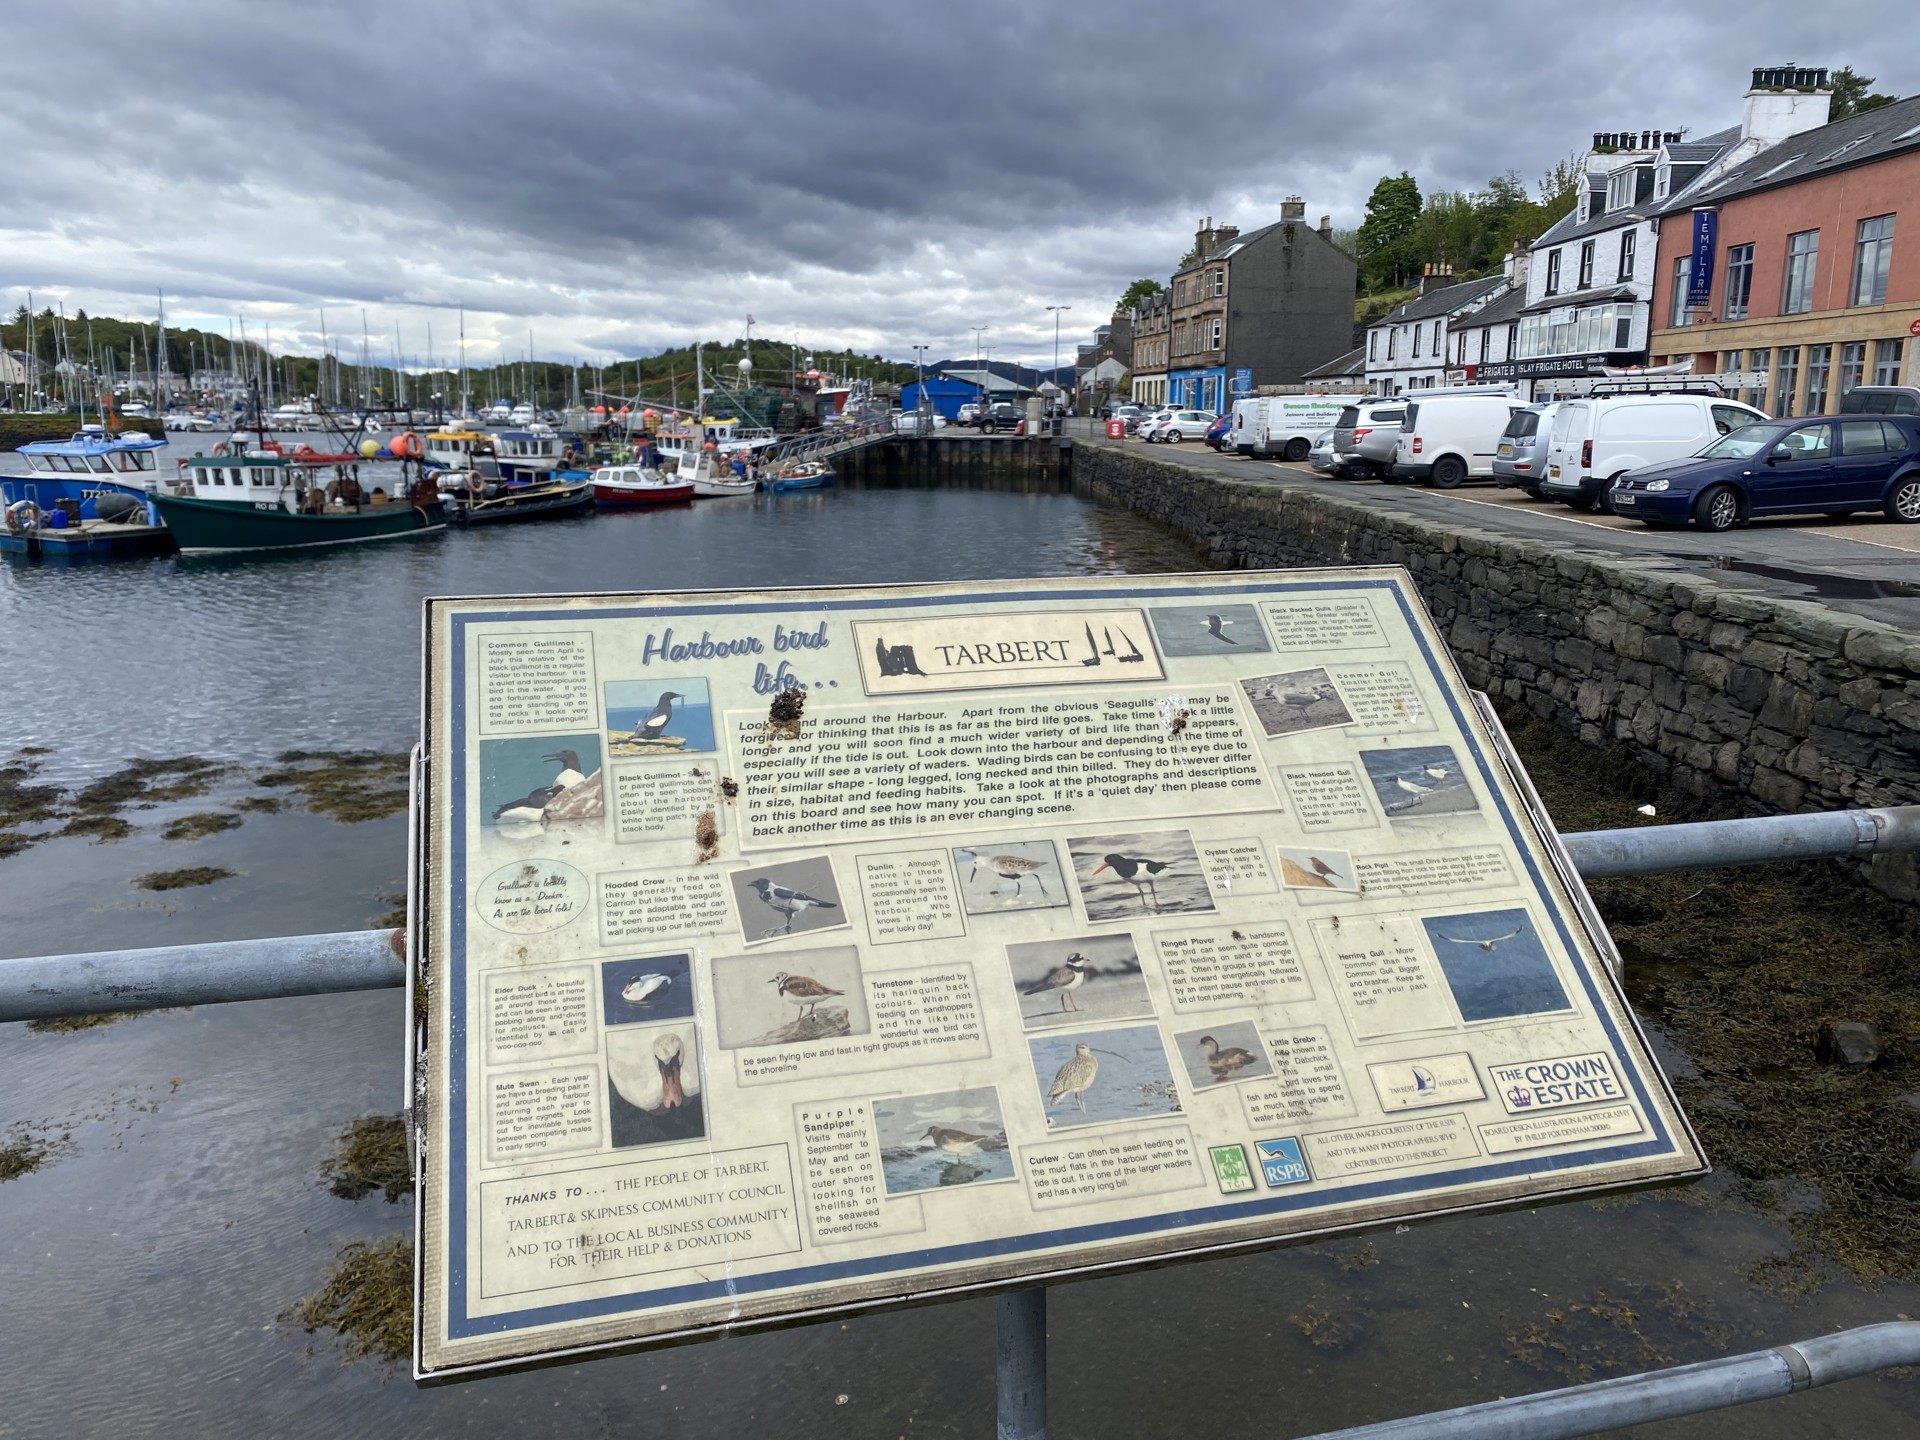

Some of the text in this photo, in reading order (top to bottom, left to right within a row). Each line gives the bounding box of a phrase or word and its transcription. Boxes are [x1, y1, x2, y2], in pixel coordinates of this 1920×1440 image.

[1697, 212, 1709, 288] TEMPLAR
[1517, 363, 1535, 373] ISLAY
[1535, 361, 1561, 372] FRIGATE
[1562, 359, 1585, 370] HOTEL
[641, 620, 830, 667] Harbour bird
[934, 640, 1070, 666] TARBERT
[618, 774, 642, 782] Black
[748, 765, 1257, 808] in size, habitat and feeding habits. Take a look at the photographs and descriptions
[750, 814, 767, 823] on
[772, 810, 796, 821] this
[800, 806, 838, 819] board
[841, 804, 866, 816] and
[870, 804, 892, 814] see
[896, 801, 922, 811] how
[926, 799, 959, 809] many
[963, 797, 986, 809] you
[989, 795, 1011, 804] can
[1015, 792, 1045, 804] spot.
[1054, 790, 1062, 799] If
[1065, 789, 1083, 799] it's
[1087, 789, 1094, 797] a
[1161, 782, 1187, 792] then
[1190, 780, 1227, 792] please
[1230, 778, 1262, 787] come
[752, 804, 1075, 836] back another time as this is an ever changing scene.
[1204, 846, 1257, 857] Oyster Catcher
[867, 859, 941, 872] Dunlin Although
[604, 880, 638, 889] Hooded
[642, 878, 665, 886] Crow
[703, 872, 719, 880] wild
[1160, 937, 1214, 948] Ringed Plover
[1337, 952, 1367, 960] Herring
[1369, 949, 1385, 957] Gull
[517, 984, 537, 992] Duck
[556, 979, 585, 988] beautiful
[871, 973, 966, 989] Turnstone Identified by
[1269, 1036, 1316, 1047] Little Grebe
[1496, 1057, 1607, 1084] THE CROWN
[496, 1075, 589, 1091] Mute Swan Each year
[1531, 1077, 1617, 1105] ESTATE
[802, 1107, 863, 1121] Purple
[803, 1120, 854, 1132] Sandpiper
[1028, 1155, 1059, 1165] Curlew
[1067, 1151, 1085, 1160] Can
[1087, 1148, 1108, 1157] often
[1122, 1144, 1142, 1152] seen
[1143, 1139, 1173, 1149] feeding
[1266, 1163, 1305, 1181] RSPB
[505, 1190, 556, 1206] THANKS
[614, 1177, 640, 1191] THE
[644, 1171, 689, 1187] PEOPLE
[693, 1168, 709, 1180] OF
[1227, 1179, 1245, 1189] TCI
[580, 1203, 639, 1221] SKIPNESS
[642, 1191, 724, 1213] COMMUNITY
[728, 1183, 786, 1201] COUNCIL
[507, 1207, 788, 1257] AND TO THE LOCAL BUSINESS COMMUNITY
[550, 1254, 577, 1269] FOR
[582, 1248, 623, 1264] THEIR
[627, 1242, 660, 1257] HELP
[677, 1229, 752, 1250] DONATIONS
